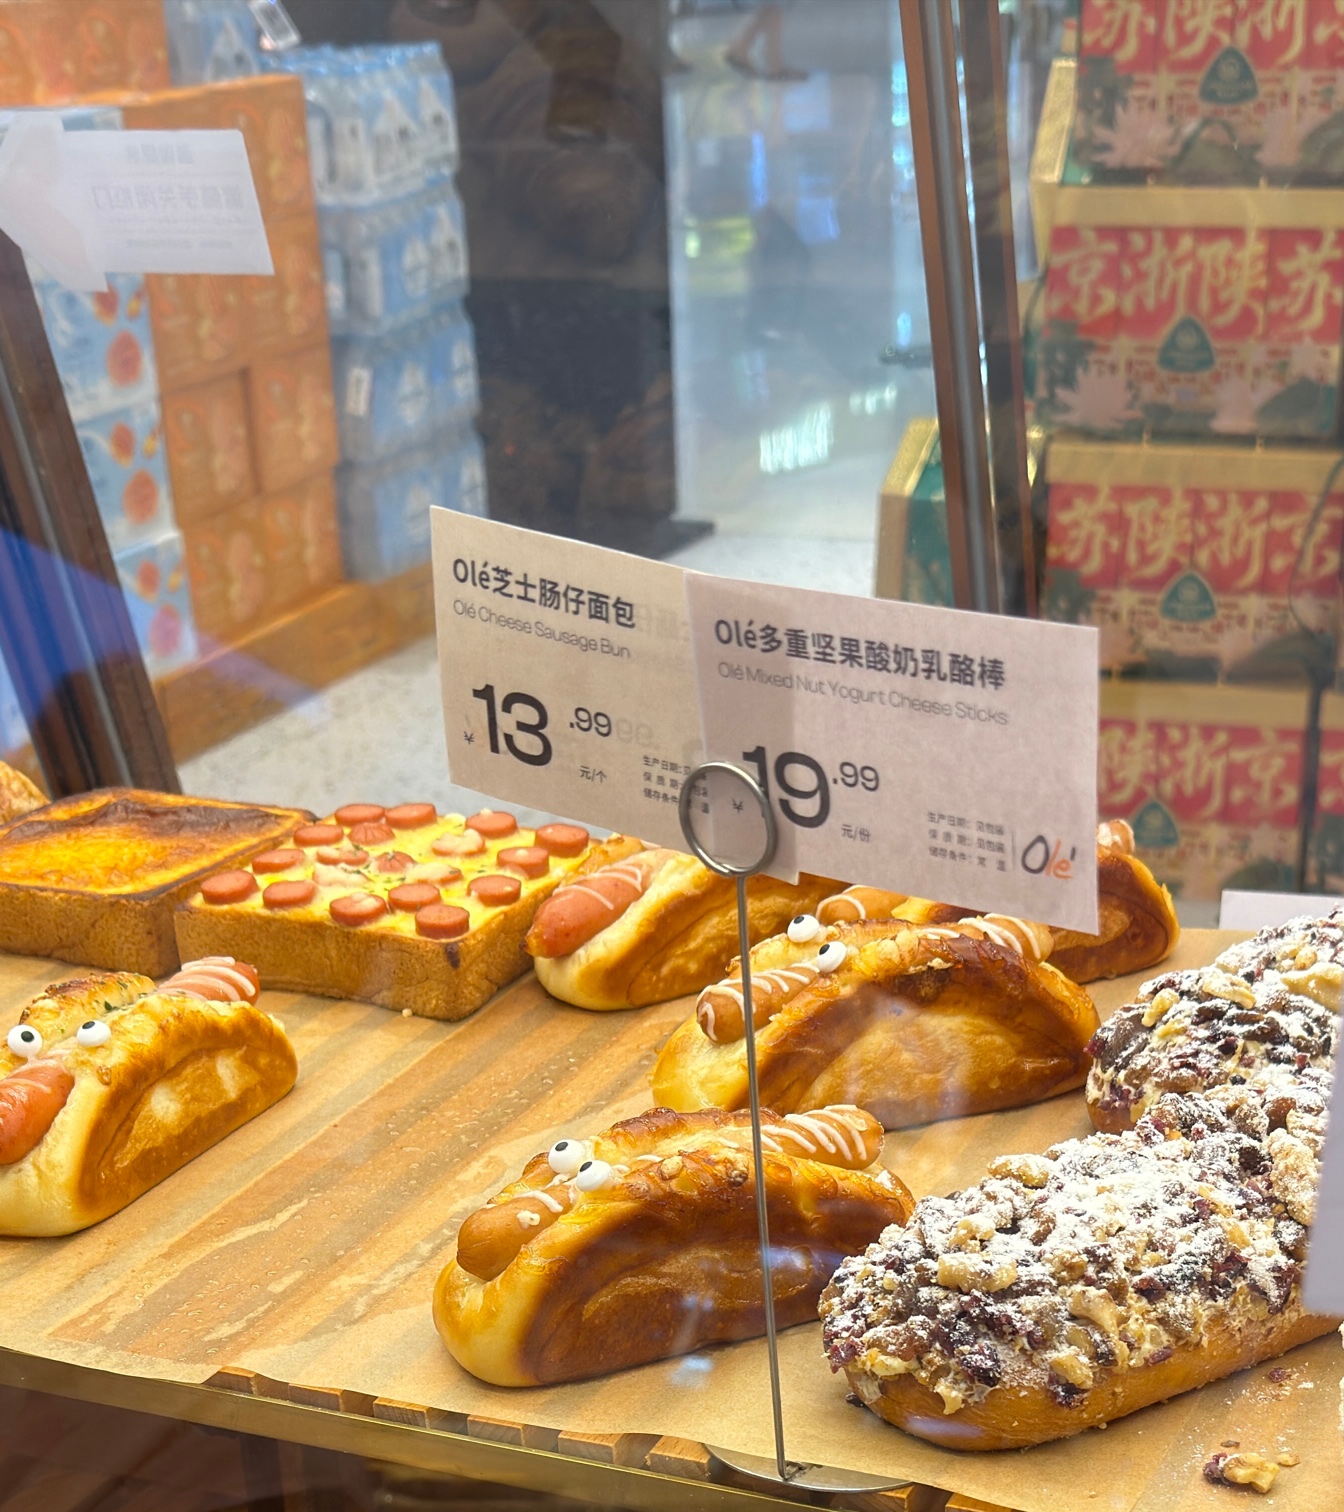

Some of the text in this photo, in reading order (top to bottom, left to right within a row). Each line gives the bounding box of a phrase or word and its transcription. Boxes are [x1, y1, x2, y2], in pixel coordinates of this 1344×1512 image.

[452, 558, 636, 629] Olé芝士肠仔面包
[453, 599, 631, 659] Olé Cheese Sausage Bun
[715, 618, 1006, 691] Olé多重坚果酸奶乳酪棒
[472, 683, 612, 767] 13.99
[718, 661, 1008, 726] Olé Mixed Nut Yogurt Cheese Sticks
[742, 745, 880, 828] 19.99
[1021, 834, 1077, 880] Olé
